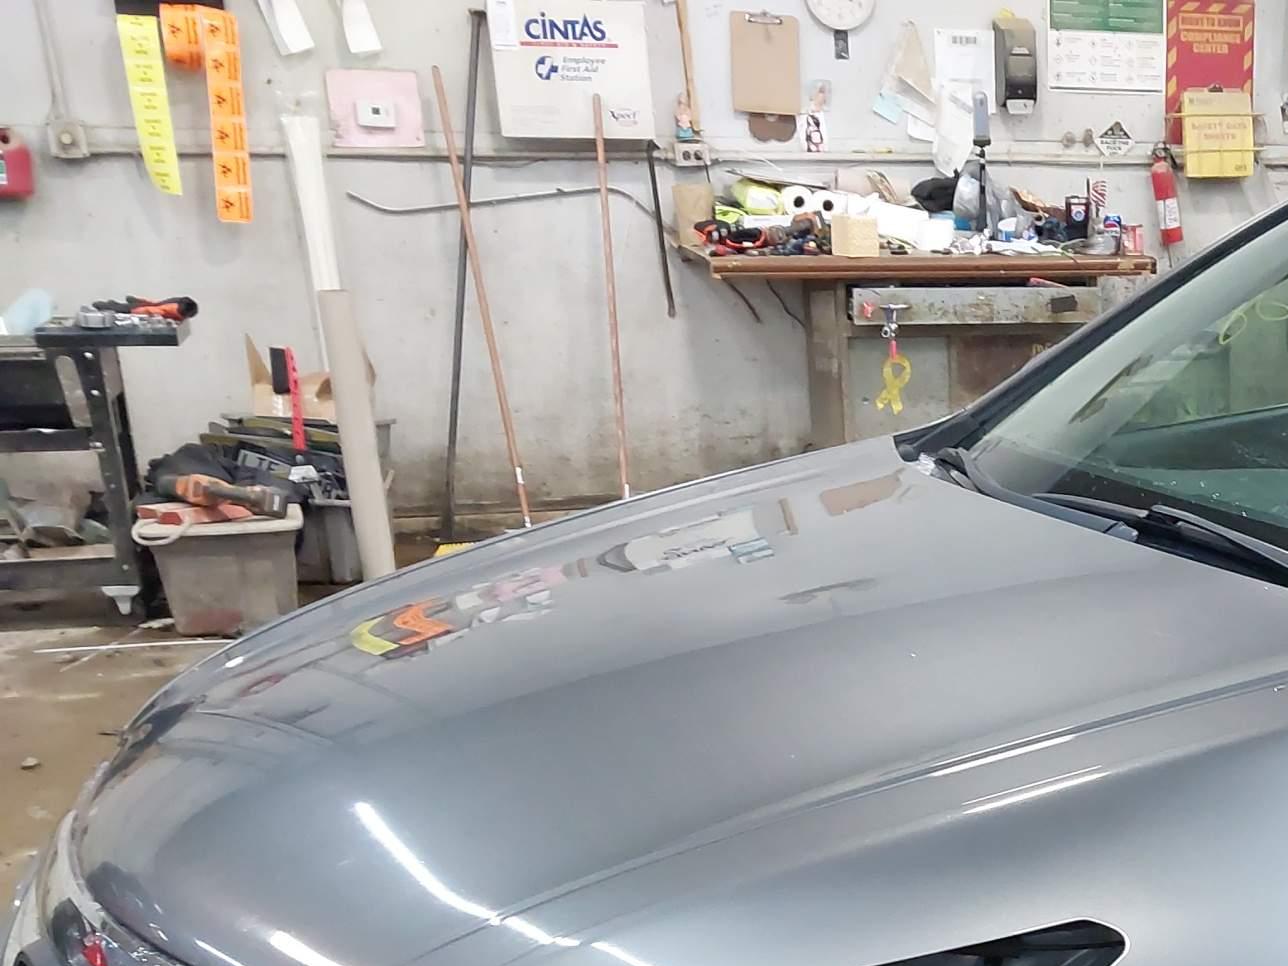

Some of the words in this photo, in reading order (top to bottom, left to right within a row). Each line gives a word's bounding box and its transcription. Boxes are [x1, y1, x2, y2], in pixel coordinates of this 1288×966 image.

[1180, 30, 1241, 43] COMPLIANCE
[1192, 42, 1228, 54] CENTER
[560, 74, 593, 82] Station
